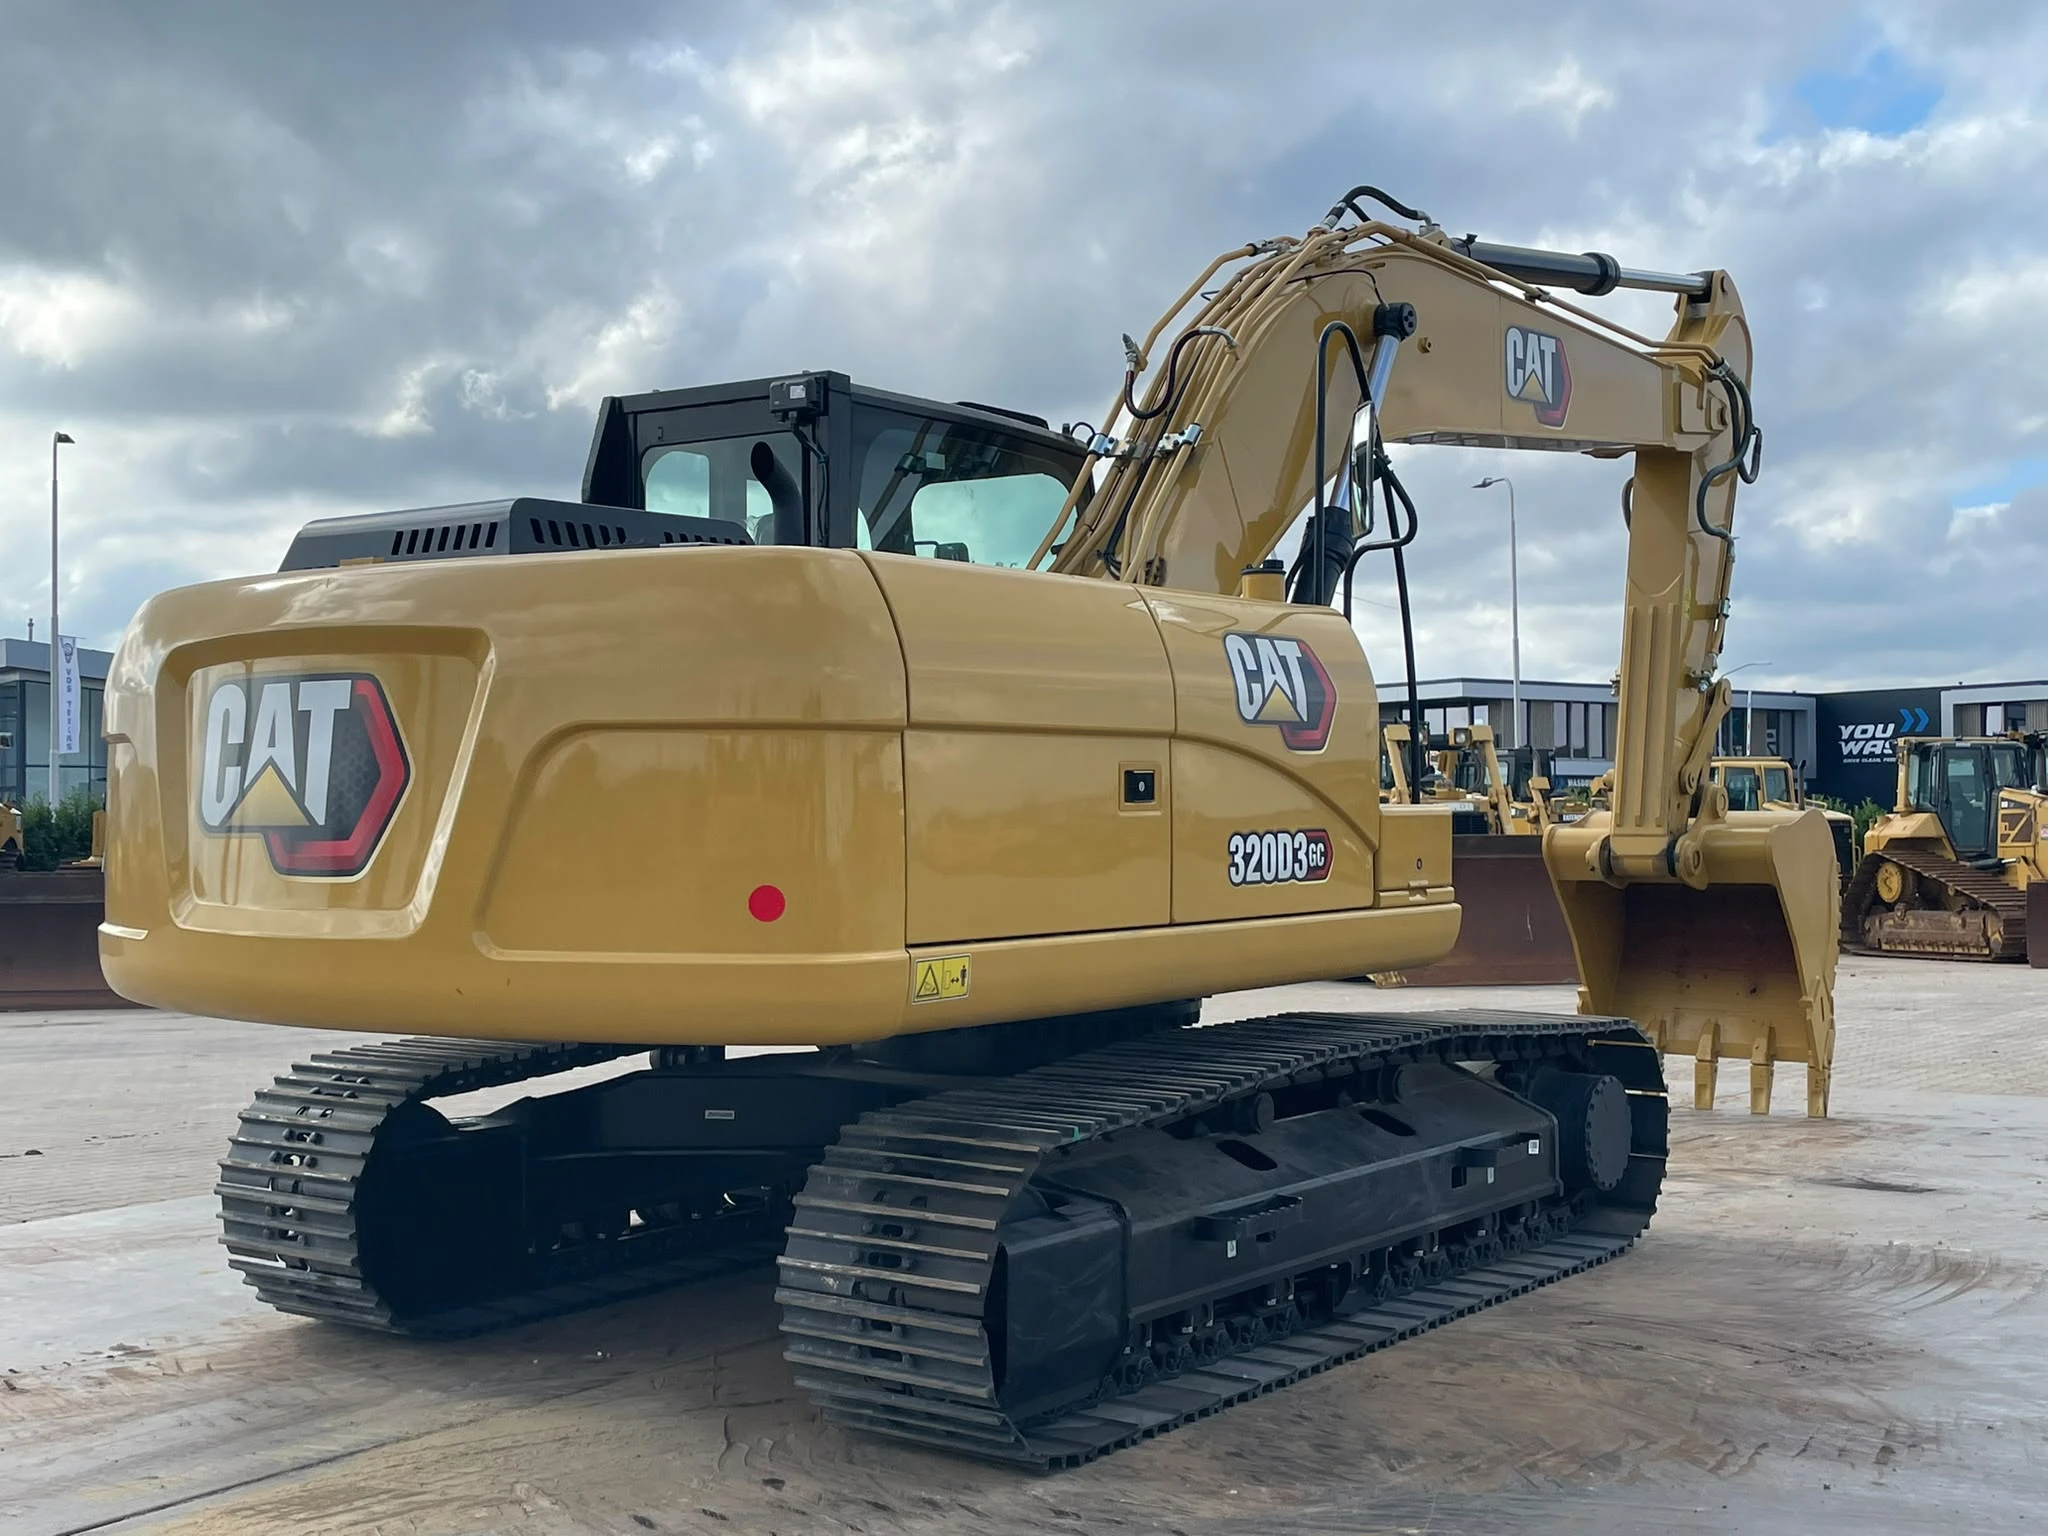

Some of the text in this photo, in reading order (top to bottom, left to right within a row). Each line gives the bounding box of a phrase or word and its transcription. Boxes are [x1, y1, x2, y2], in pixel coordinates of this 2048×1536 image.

[1506, 327, 1556, 404] CAT
[1225, 634, 1308, 722] CAT
[202, 679, 352, 827] CAT
[1838, 723, 1895, 739] YOU
[1229, 832, 1325, 883] 320D3 GC
